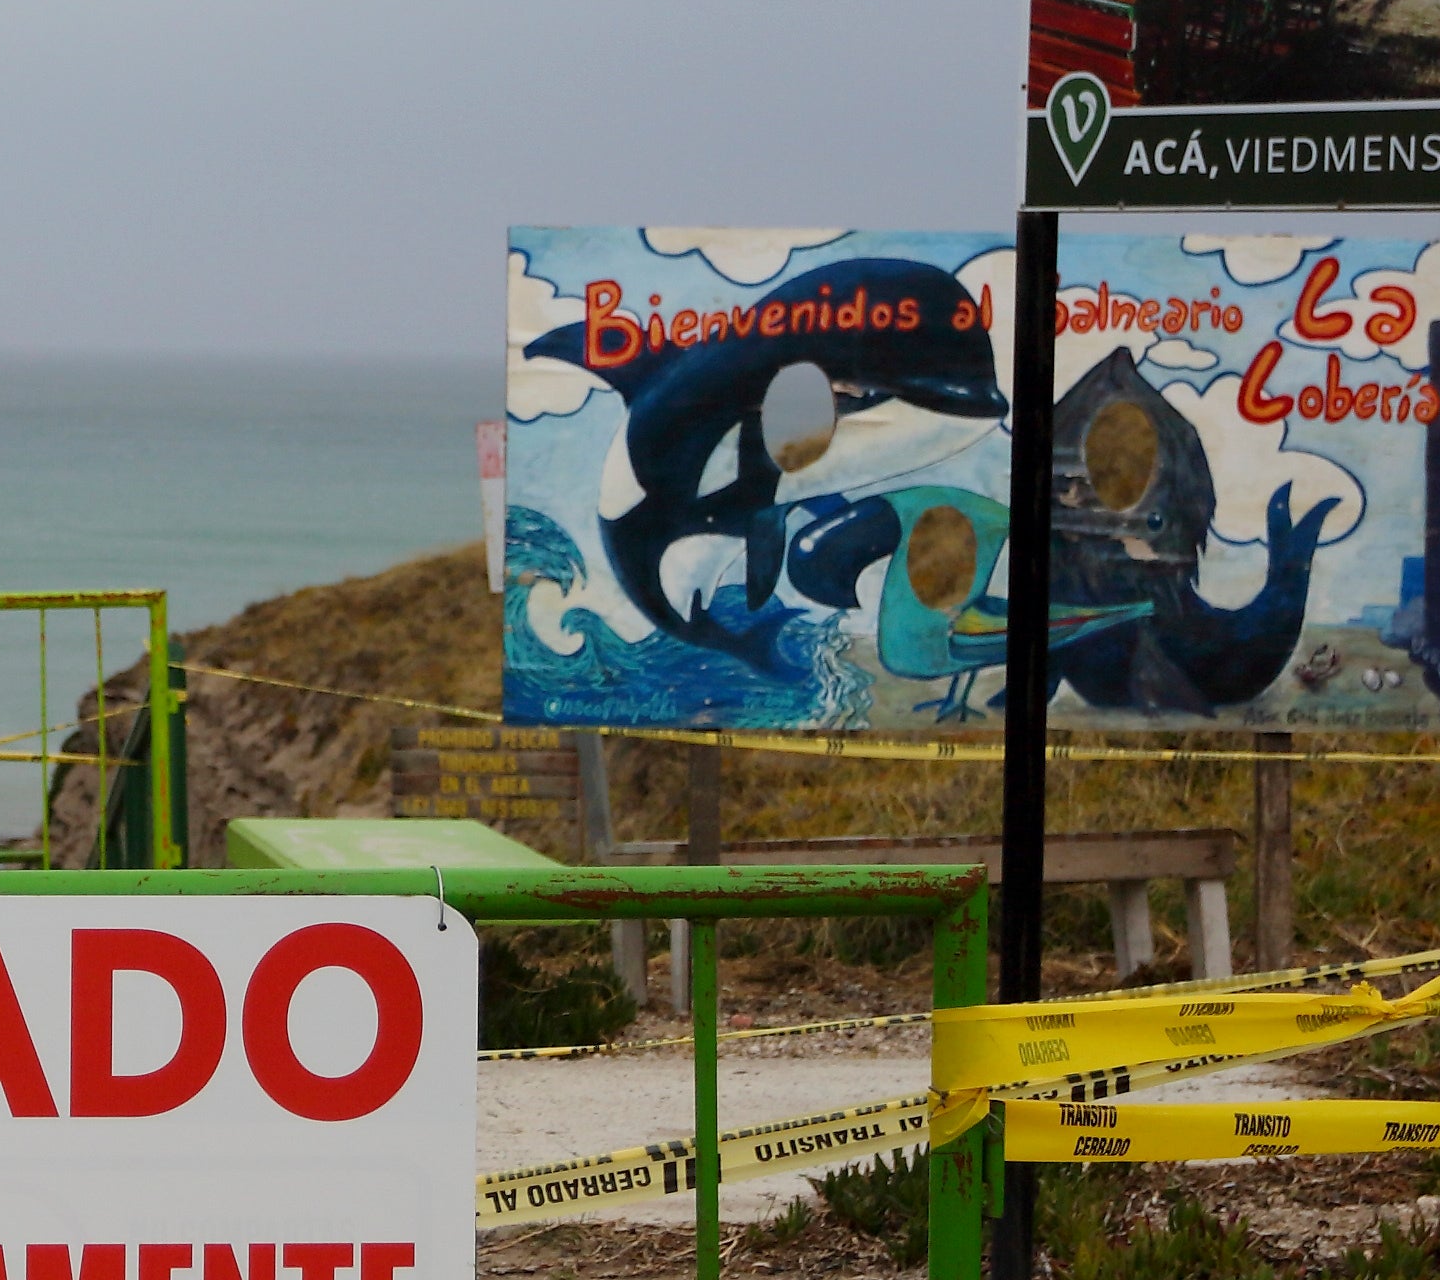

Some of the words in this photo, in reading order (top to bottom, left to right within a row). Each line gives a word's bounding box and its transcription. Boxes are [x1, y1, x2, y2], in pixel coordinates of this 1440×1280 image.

[1123, 129, 1219, 180] ACÁ,
[584, 279, 919, 369] Bienvenidos
[951, 283, 993, 332] al
[1294, 256, 1418, 346] La
[1059, 1103, 1117, 1128] TRANSITO
[1234, 1113, 1291, 1138] TRANSITO
[1382, 1122, 1440, 1143] TRANSITO
[1073, 1137, 1131, 1157] CERRADO
[527, 1166, 652, 1208] CERRADO
[485, 1191, 518, 1213] AL
